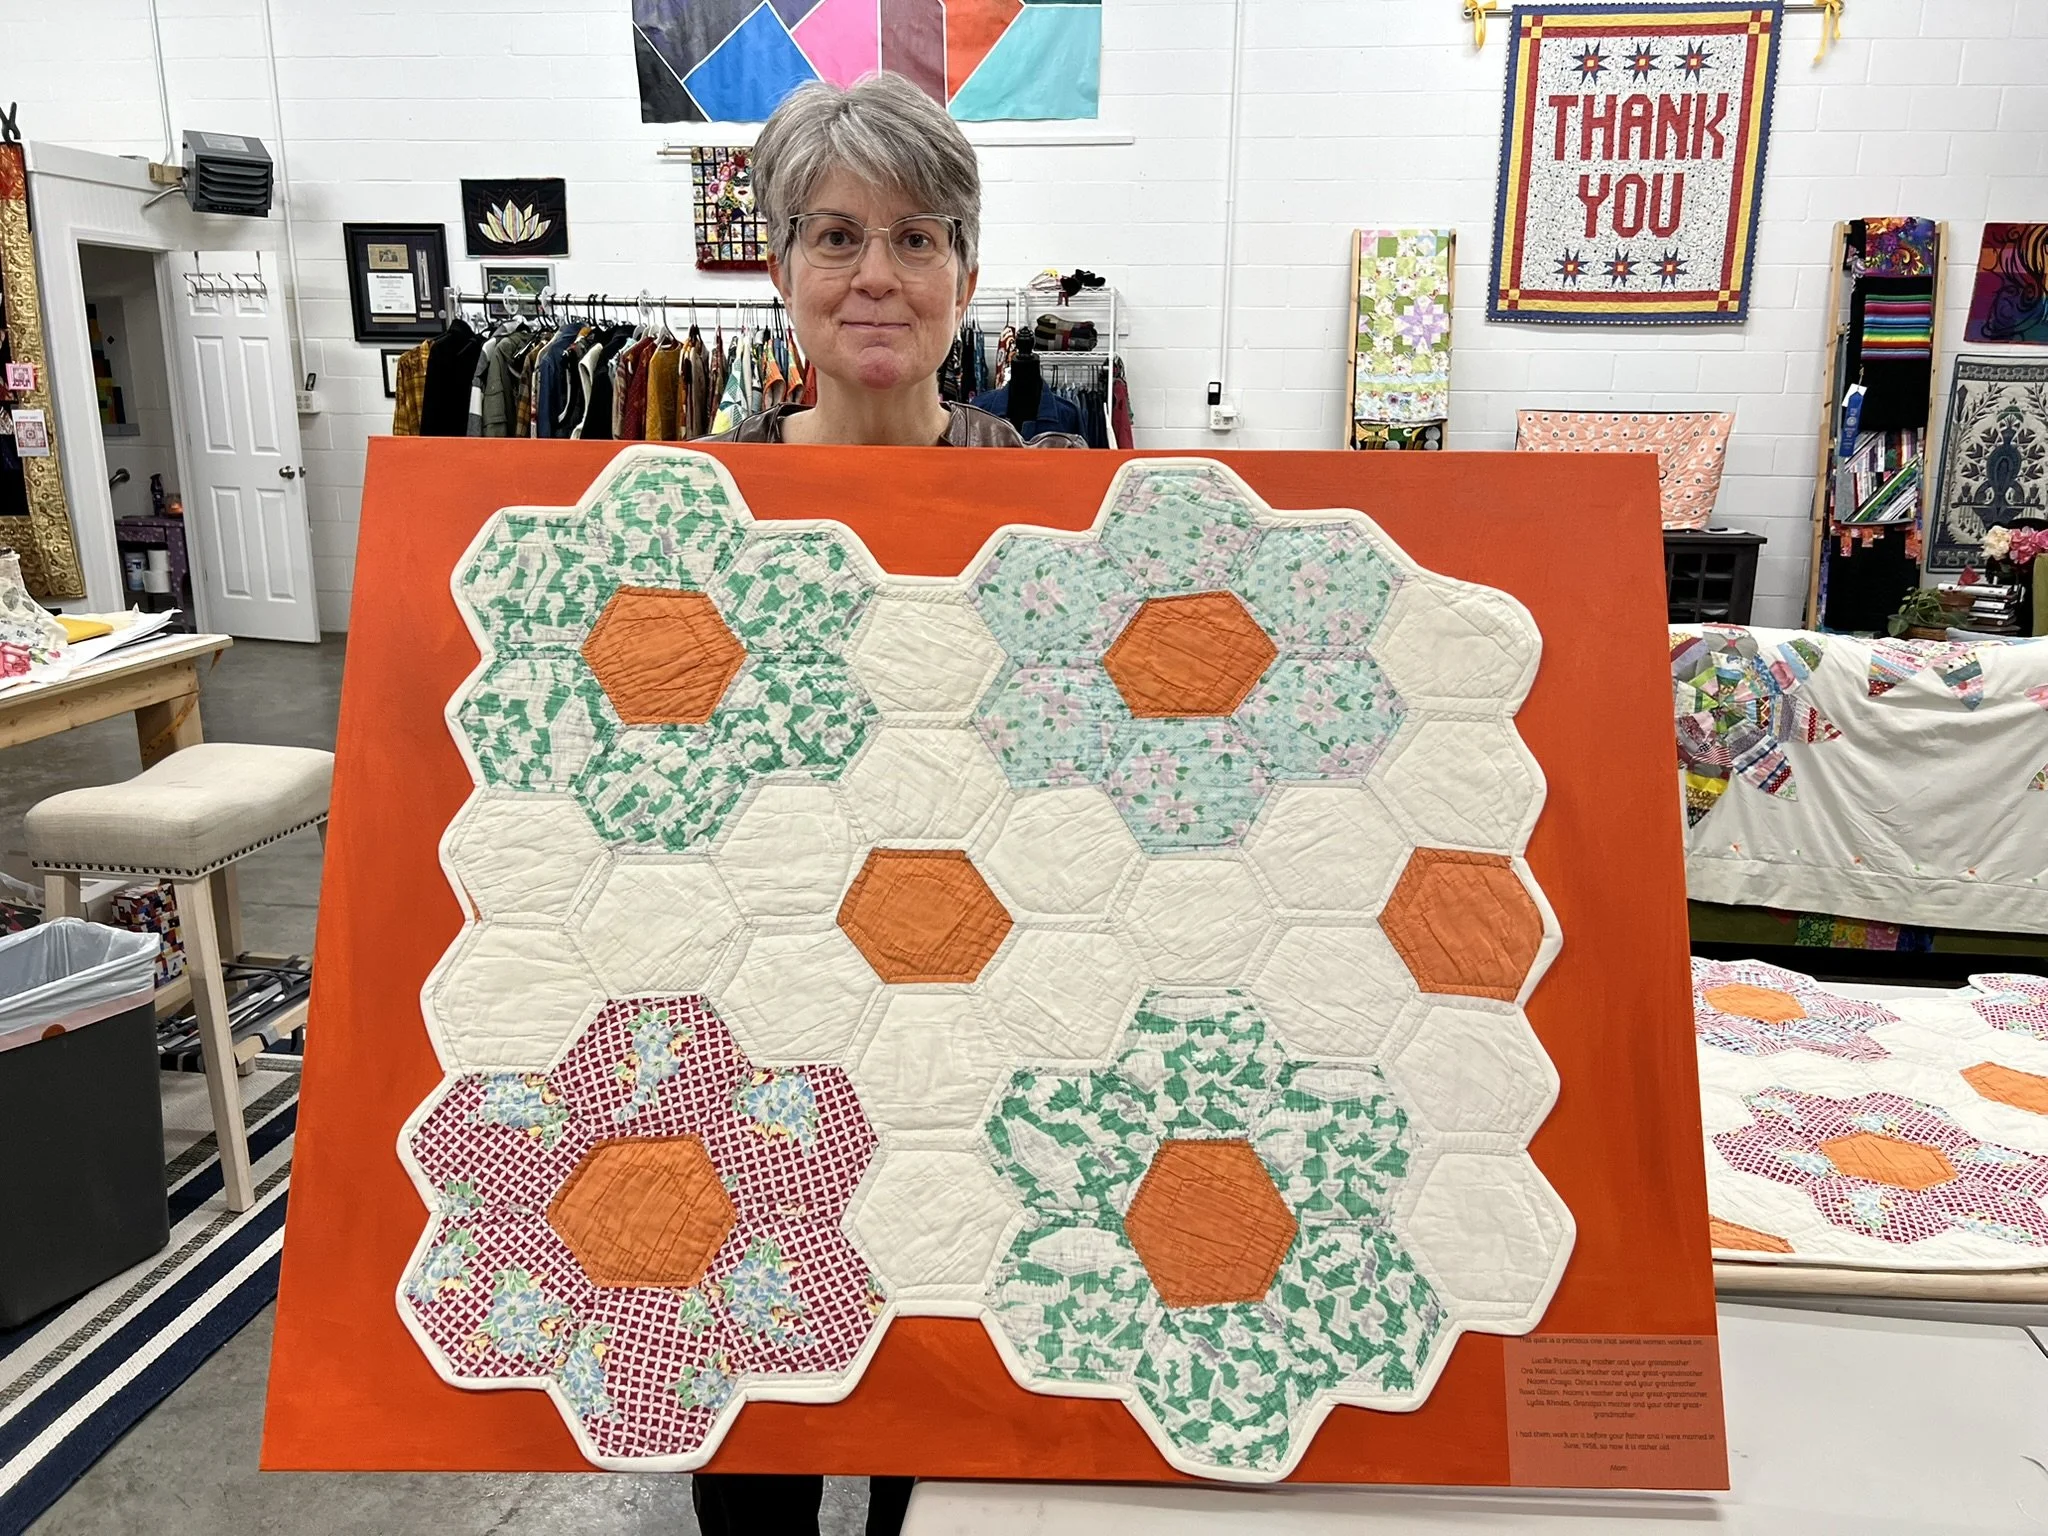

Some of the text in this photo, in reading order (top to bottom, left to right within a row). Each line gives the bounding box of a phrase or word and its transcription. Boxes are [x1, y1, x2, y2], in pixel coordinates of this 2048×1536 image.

[1548, 93, 1729, 160] THANK
[1578, 172, 1684, 238] YOU
[1533, 1337, 1548, 1345] quilt
[1562, 1337, 1589, 1345] precious
[1531, 1357, 1552, 1365] Lucille
[1580, 1359, 1591, 1367] my
[1559, 1368, 1585, 1376] Lucille's
[1625, 1370, 1641, 1378] your
[1629, 1391, 1644, 1399] your
[1647, 1402, 1662, 1410] your
[1682, 1402, 1703, 1410] great-
[1587, 1432, 1608, 1440] before
[1609, 1433, 1624, 1441] your
[1625, 1432, 1645, 1441] father
[1682, 1433, 1707, 1441] married
